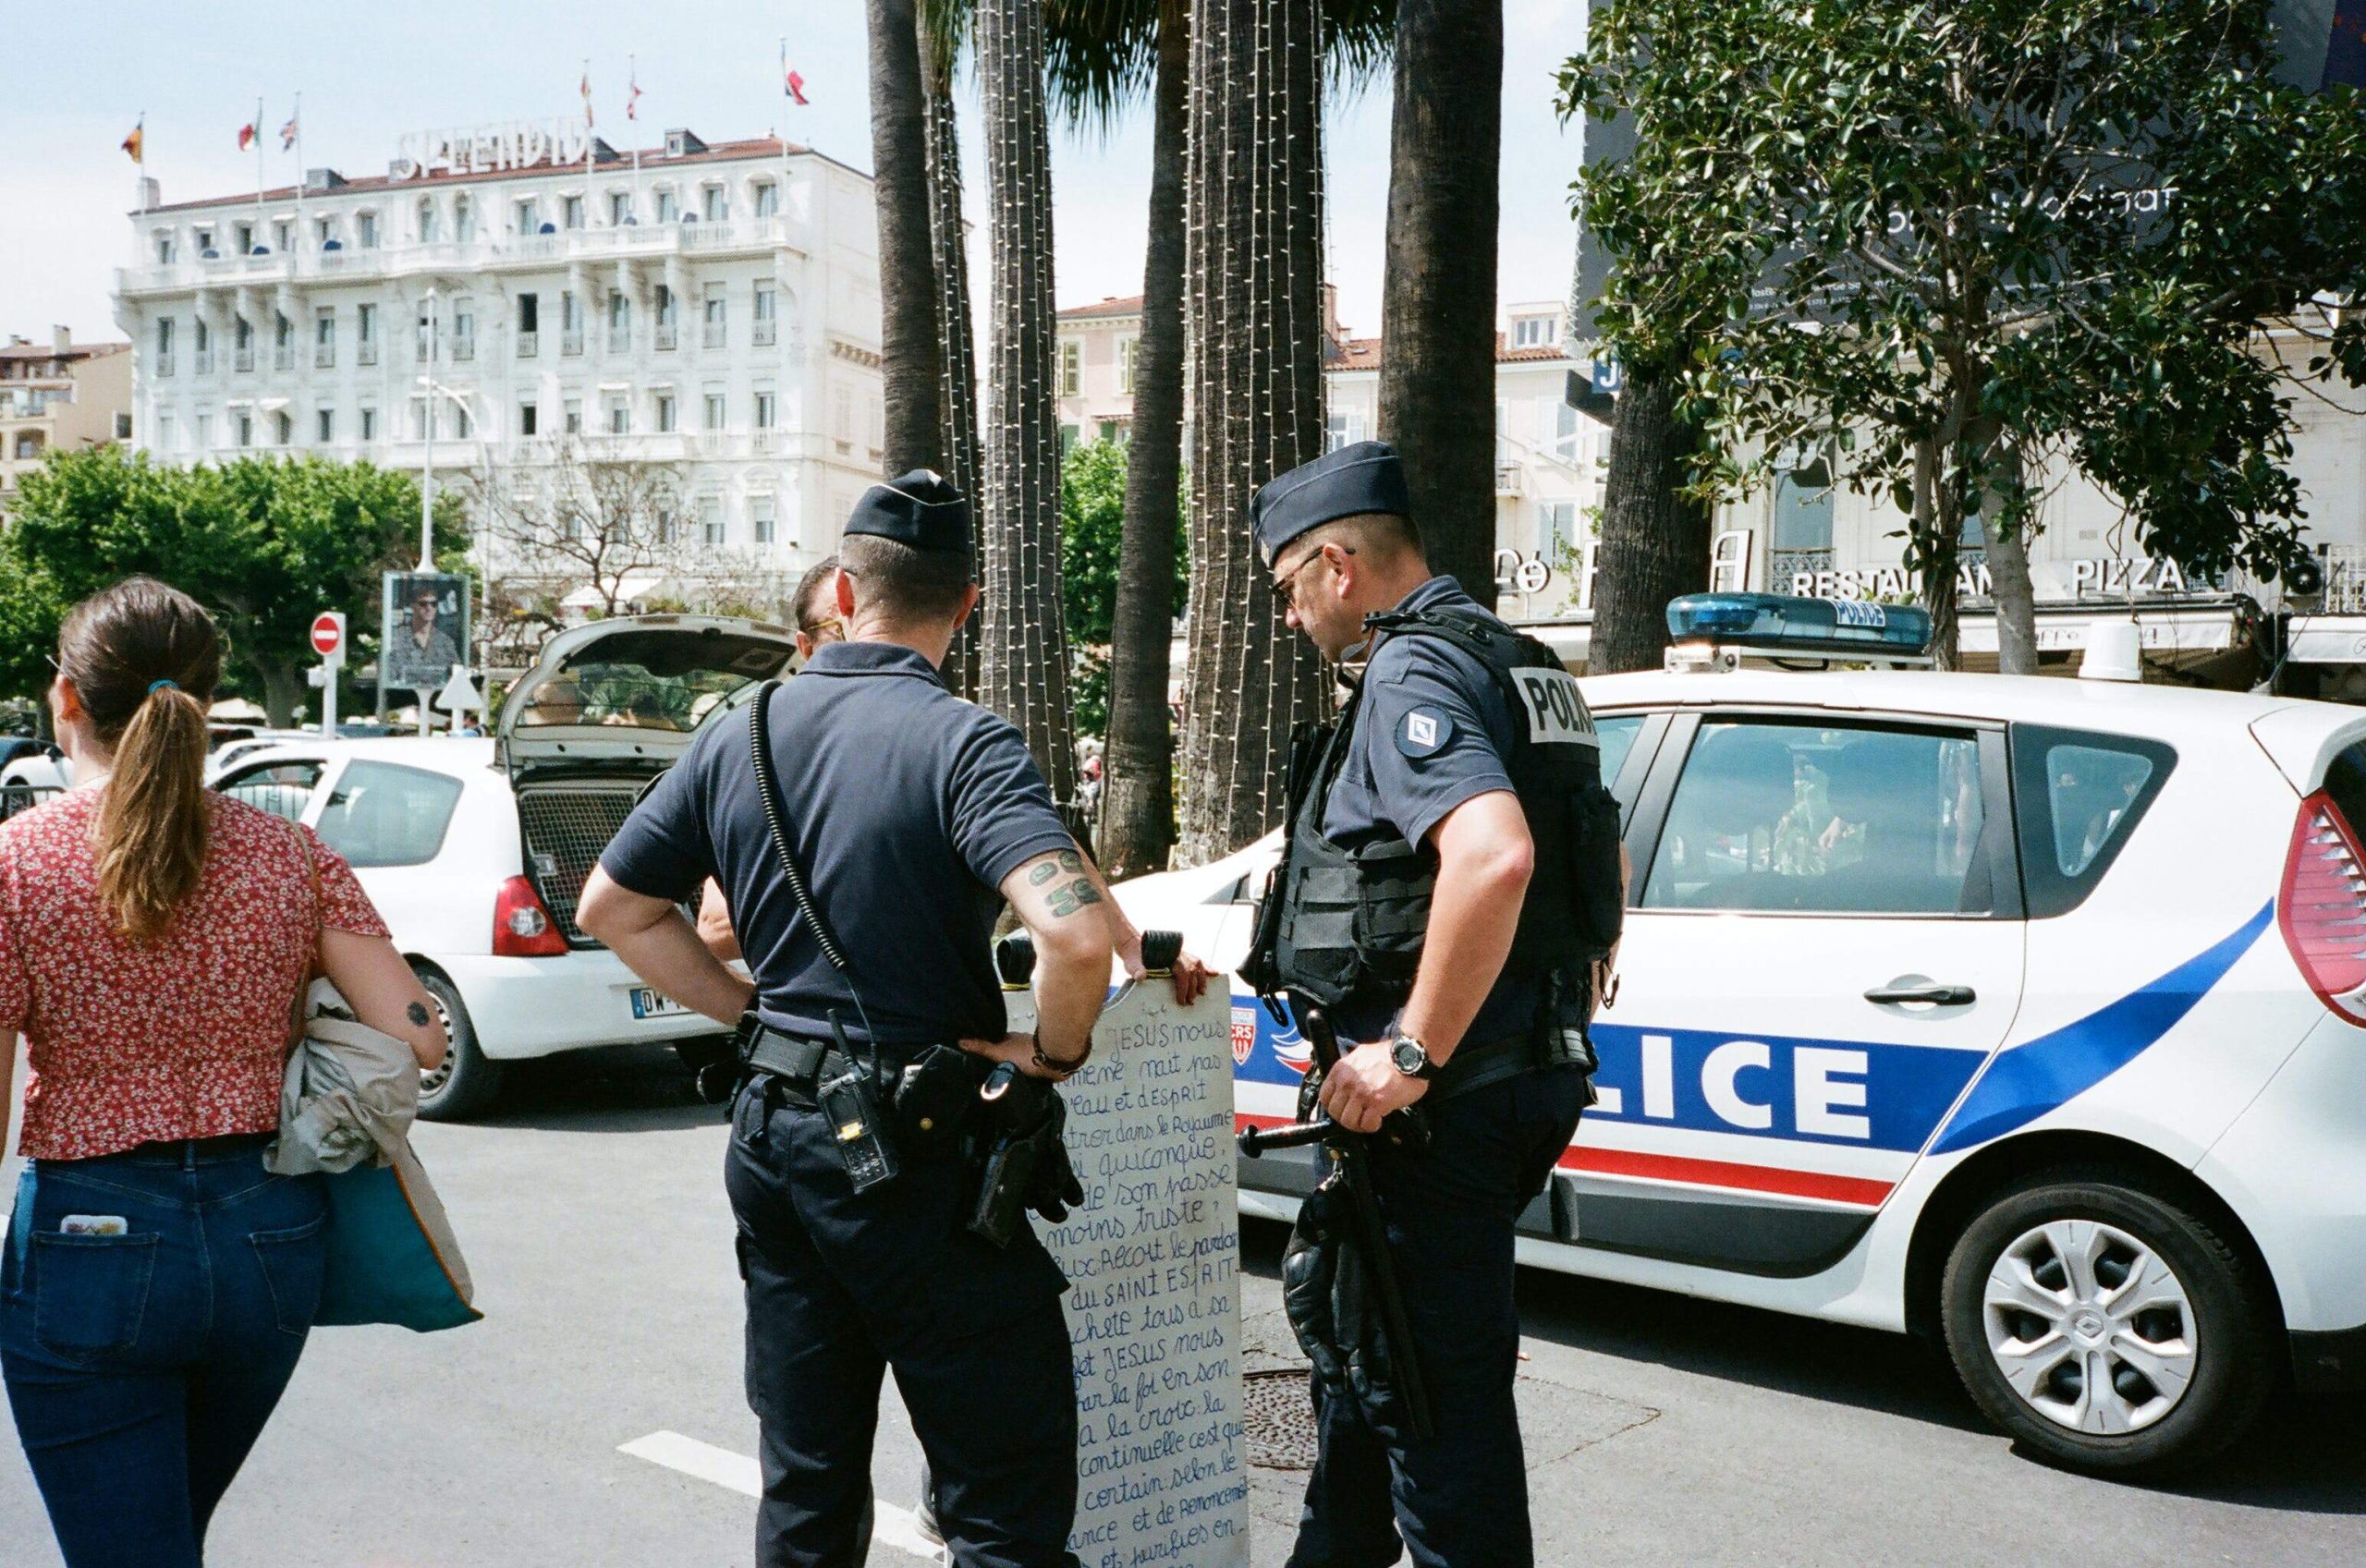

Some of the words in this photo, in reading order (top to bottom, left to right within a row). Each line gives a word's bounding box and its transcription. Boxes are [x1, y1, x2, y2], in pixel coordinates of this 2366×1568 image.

[2071, 554, 2185, 592] PIZZA
[1835, 601, 1884, 626] POLICE
[1106, 1023, 1169, 1063] JESUS
[1115, 1086, 1134, 1111] et
[1116, 1118, 1153, 1143] dans
[1046, 1213, 1125, 1248] moins
[1071, 1283, 1099, 1311] du
[1104, 1339, 1167, 1383] JESUS
[1174, 1326, 1224, 1355] nous
[1109, 1382, 1131, 1407] la
[1106, 1413, 1132, 1440] la
[1132, 1507, 1152, 1531] et
